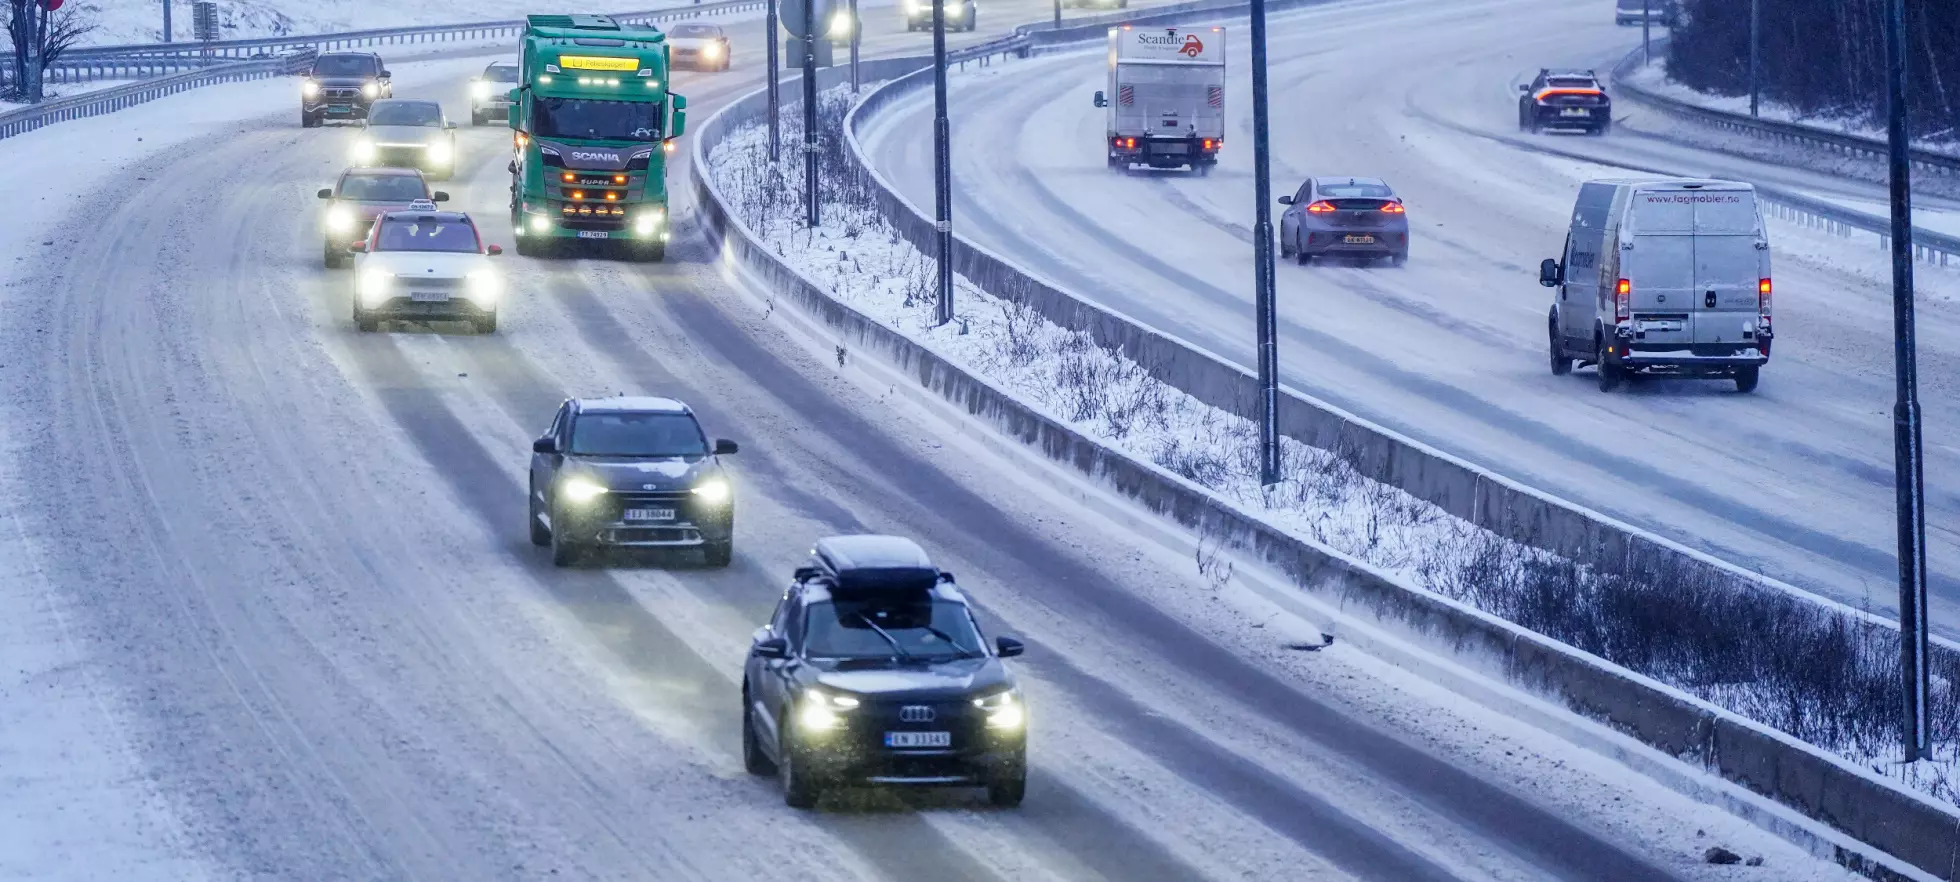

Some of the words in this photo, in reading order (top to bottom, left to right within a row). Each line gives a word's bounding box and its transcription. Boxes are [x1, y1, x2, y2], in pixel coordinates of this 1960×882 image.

[1138, 33, 1185, 45] Scandic
[571, 151, 620, 162] SCANIA
[1646, 194, 1740, 204] www.fagmobler.no
